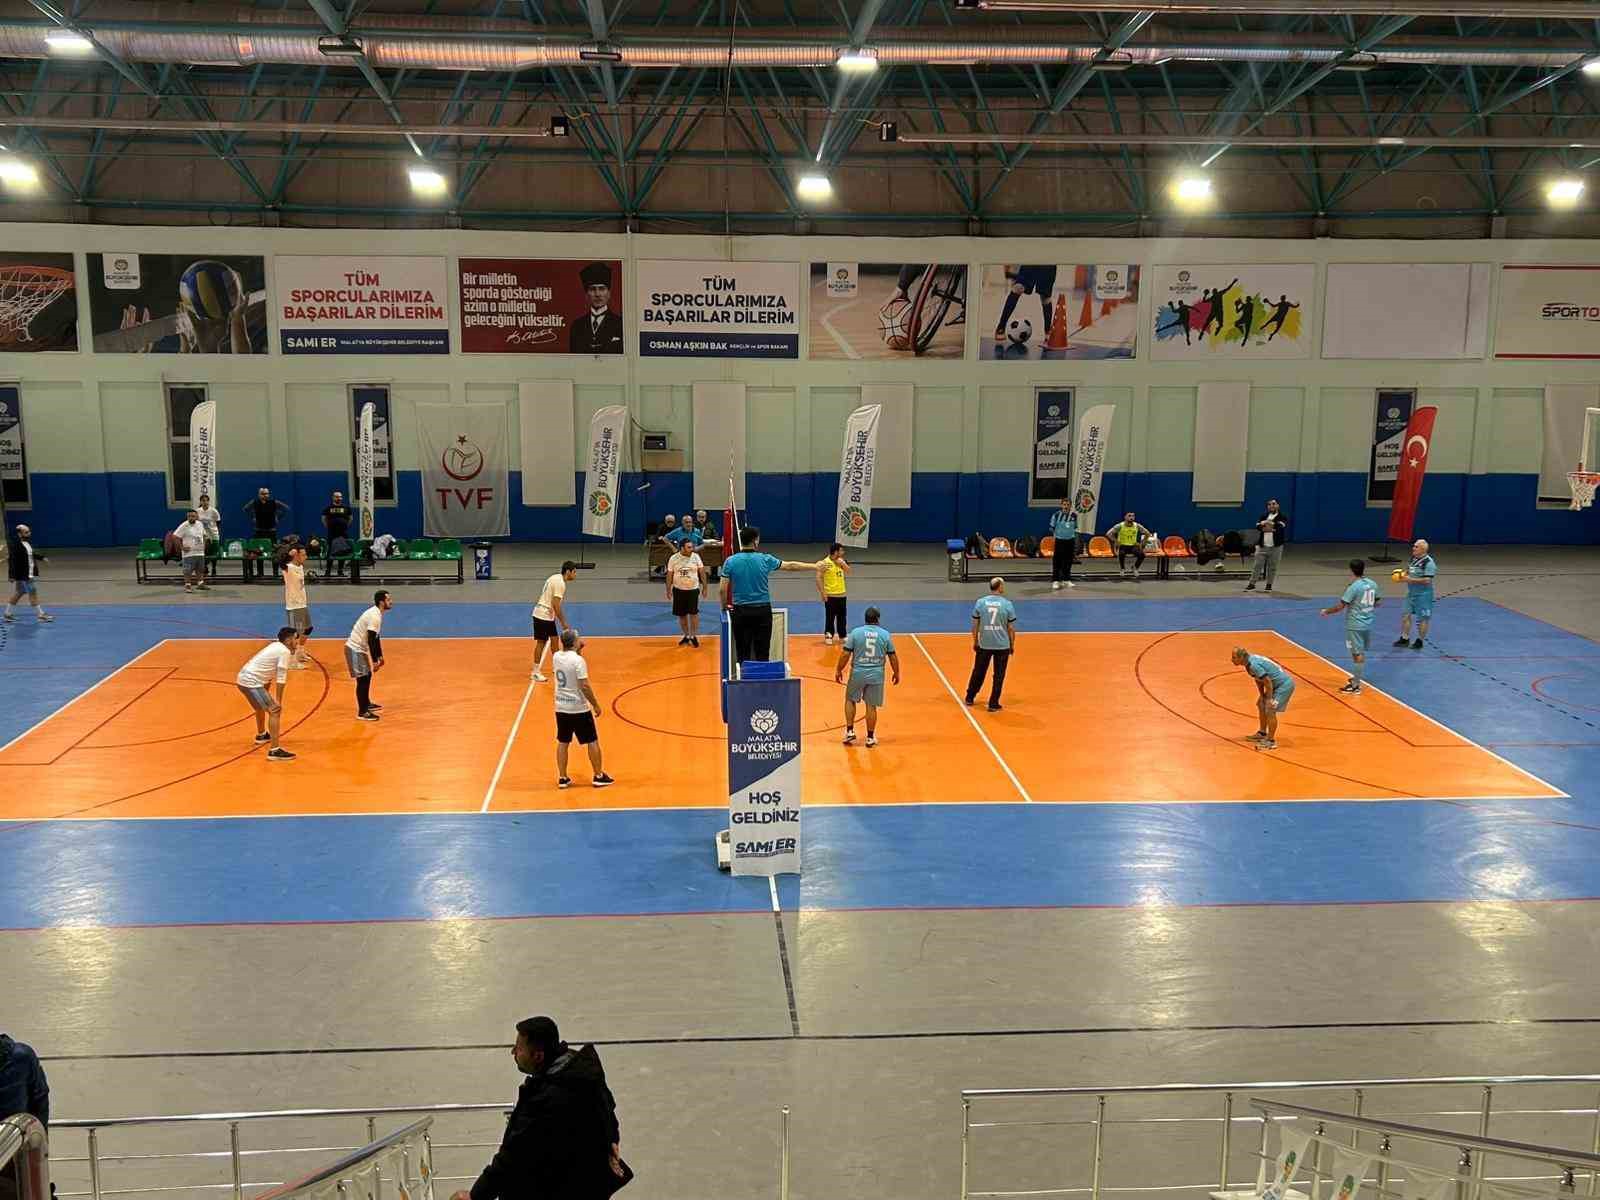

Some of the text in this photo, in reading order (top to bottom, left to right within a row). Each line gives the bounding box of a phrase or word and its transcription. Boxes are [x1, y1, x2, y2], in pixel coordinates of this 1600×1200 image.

[344, 270, 380, 287] TÜM
[463, 272, 518, 285] Bir milletin
[703, 275, 736, 291] TÜM
[291, 289, 434, 303] SPORCULARIMIZA
[463, 286, 552, 301] sporda gösterdiği
[652, 293, 787, 308] SPORCULARIMIZA
[284, 303, 443, 322] BAŞARILAR DİLERİM
[464, 301, 537, 313] azim o milletin
[464, 314, 516, 328] geleceğini
[644, 308, 794, 325] BAŞARILAR DİLERİM
[319, 338, 337, 347] ER
[649, 341, 682, 350] OSMAN
[683, 341, 709, 352] AŞKIN
[710, 342, 728, 351] BAK
[436, 488, 494, 510] TVF
[988, 607, 998, 625] 7
[865, 638, 876, 657] 5
[556, 669, 567, 688] 9
[747, 734, 781, 742] MALATYA
[748, 791, 781, 806] HOŞ
[732, 807, 800, 824] GELDİNİZ
[775, 838, 797, 849] ER
